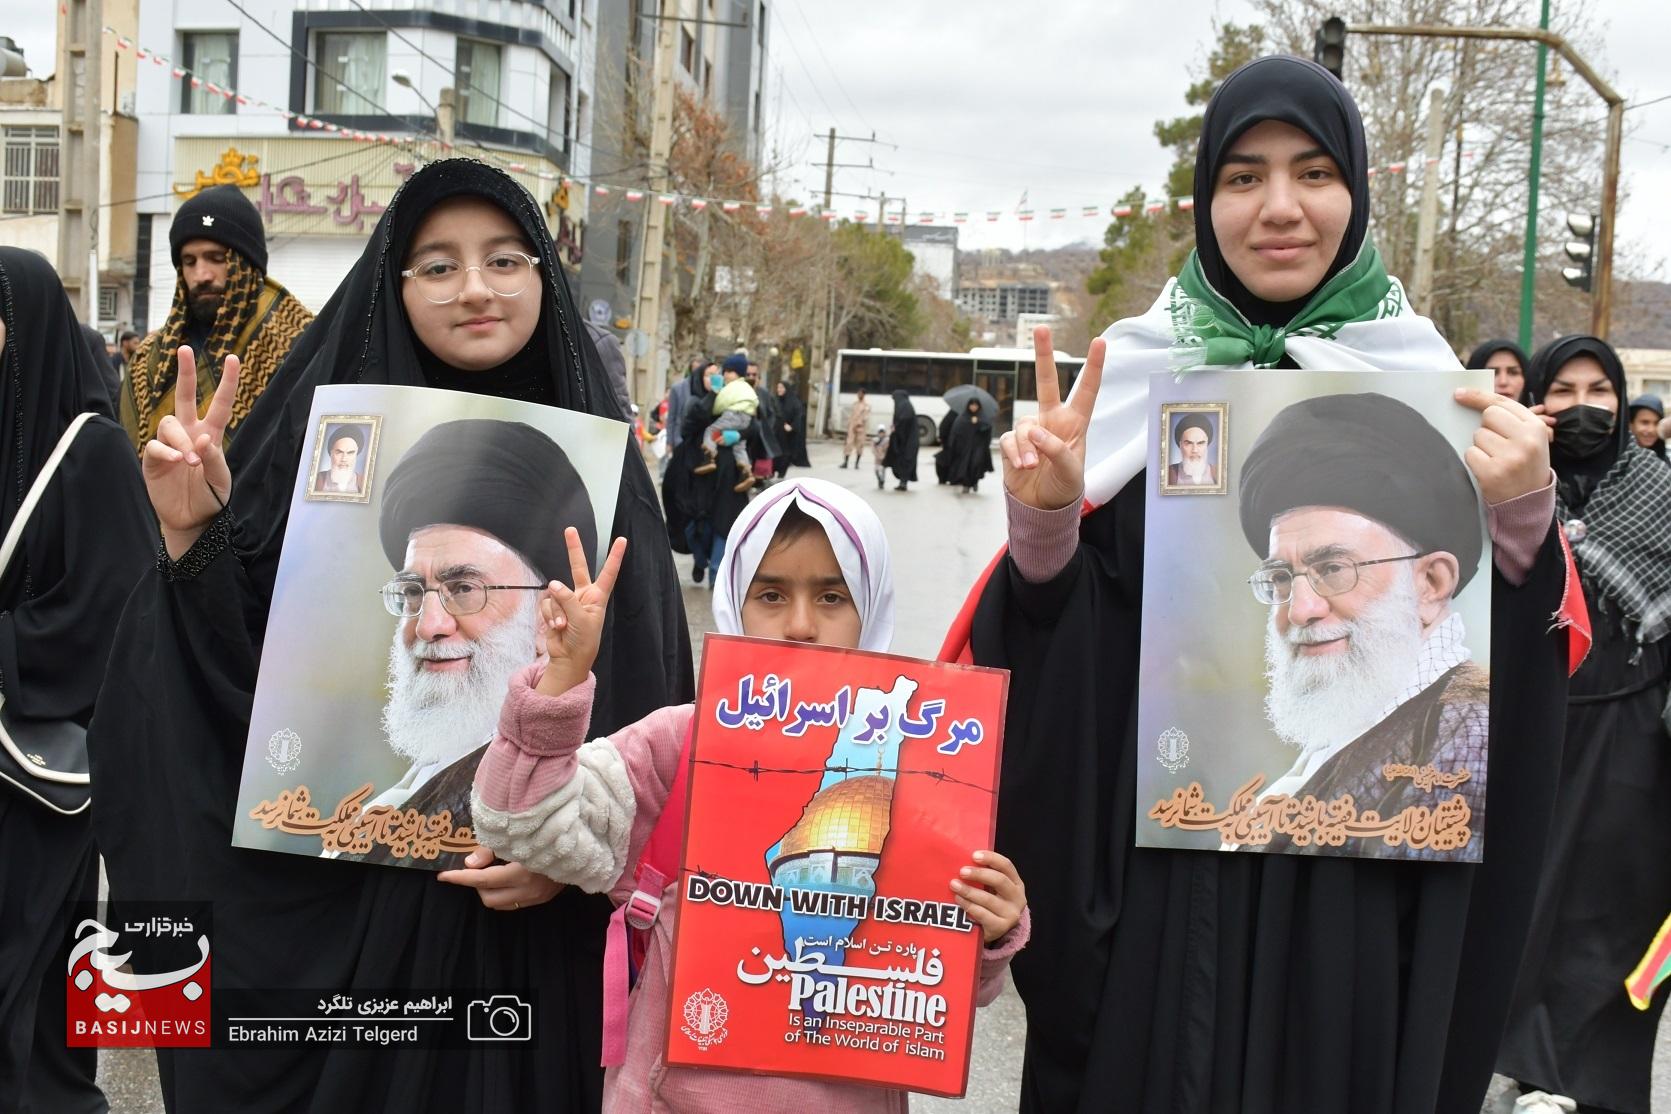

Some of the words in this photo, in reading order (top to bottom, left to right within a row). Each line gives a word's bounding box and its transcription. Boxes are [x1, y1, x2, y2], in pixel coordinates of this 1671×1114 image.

[717, 673, 853, 737] اسرائیل
[852, 702, 892, 744] بر
[899, 700, 984, 754] مرگ
[255, 795, 288, 825] نرسد
[281, 786, 370, 830] مملکت
[287, 790, 307, 821] شما
[1153, 792, 1183, 823] نرسد
[1179, 777, 1262, 825] مملکت
[1184, 785, 1200, 817] شما
[1235, 798, 1285, 841] آسیبی
[1279, 802, 1298, 829] تا
[1292, 799, 1326, 842] باشید
[1326, 798, 1353, 842] فقیه
[337, 809, 394, 850] آسیبی
[380, 815, 400, 839] تا
[398, 813, 423, 854] باشید
[424, 815, 448, 855] فقیه
[1344, 808, 1426, 842] ولایت
[1411, 798, 1467, 845] پشتیبان
[688, 875, 784, 911] DOWN
[790, 889, 868, 918] WITH
[874, 897, 973, 931] ISRAEL
[736, 936, 944, 986] فلسطین
[803, 936, 832, 948] است
[834, 936, 867, 951] اسلام
[868, 940, 893, 956] تن
[895, 945, 918, 959] پاره
[788, 972, 947, 1028] Palestine
[784, 1029, 800, 1043] of
[803, 1030, 831, 1045] The
[834, 1033, 879, 1051] World
[882, 1038, 900, 1053] of
[905, 1042, 945, 1060] islam
[789, 1013, 801, 1026] Is
[803, 1017, 821, 1028] an
[825, 1016, 911, 1038] Inseparable
[915, 1027, 944, 1044] Part
